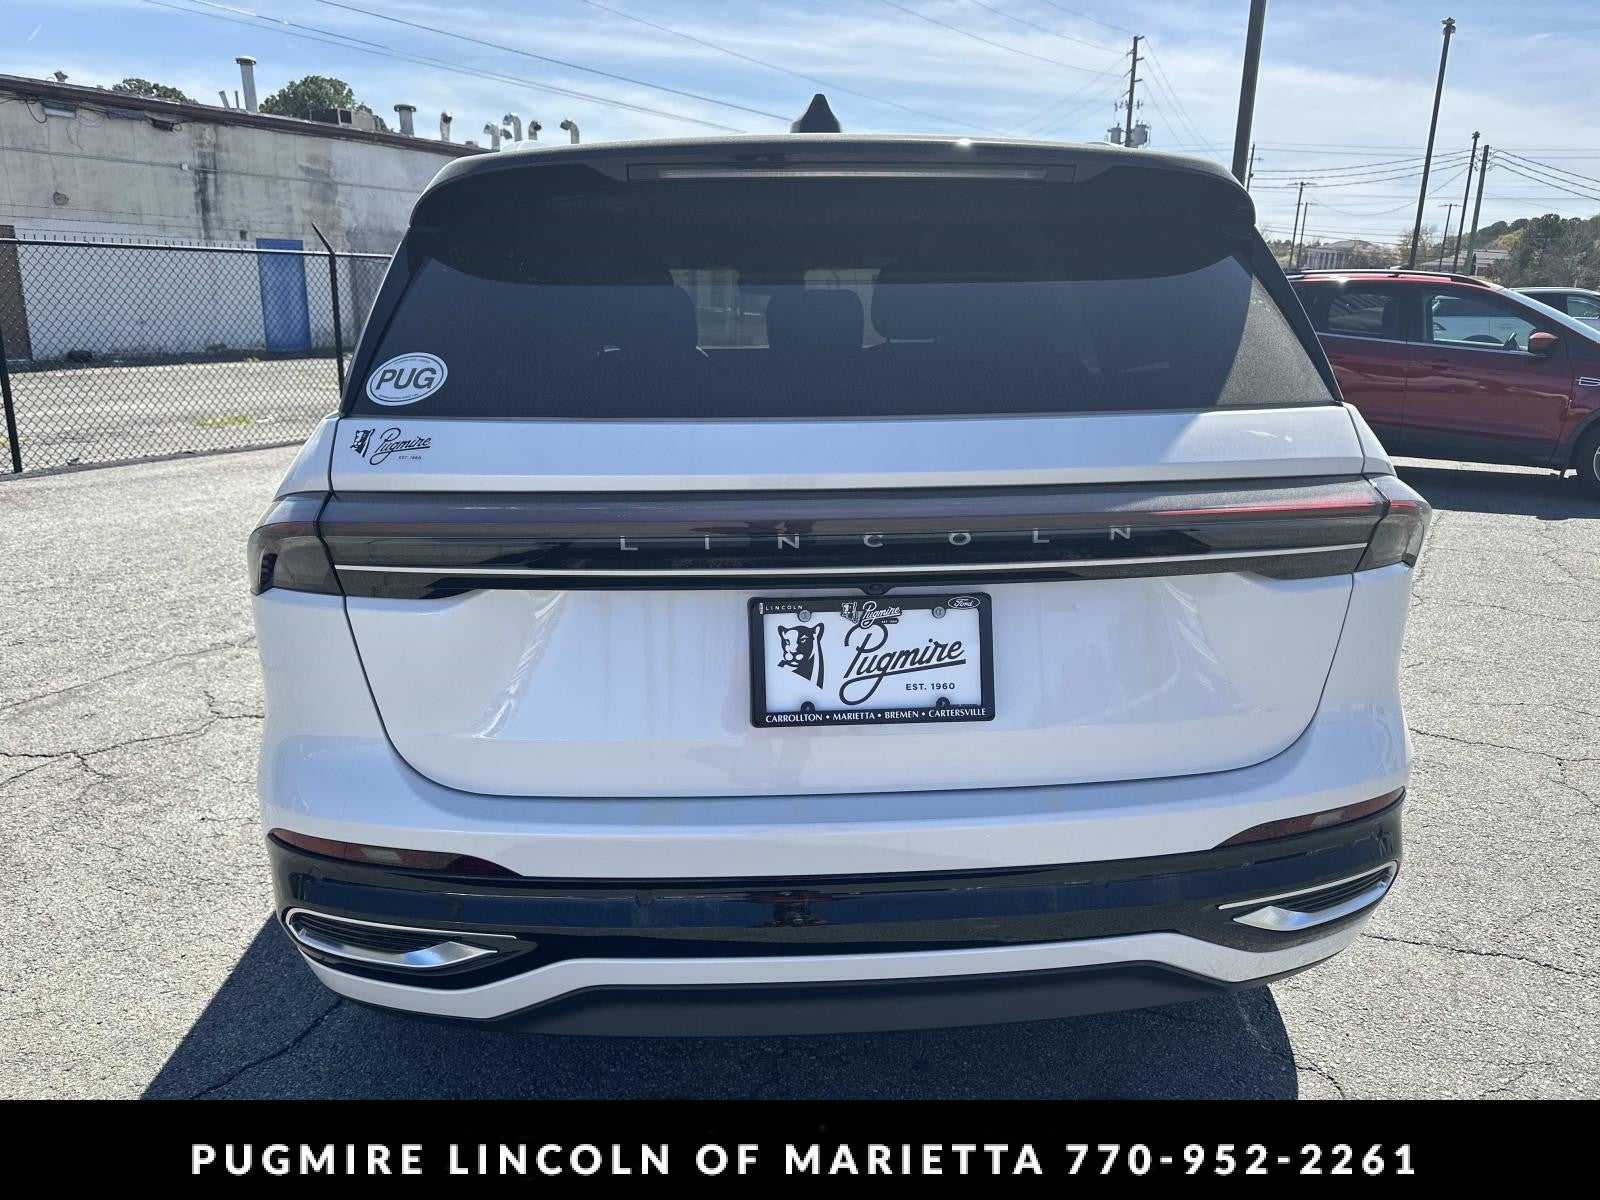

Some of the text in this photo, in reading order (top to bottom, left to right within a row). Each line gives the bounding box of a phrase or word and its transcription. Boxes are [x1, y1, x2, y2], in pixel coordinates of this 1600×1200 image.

[375, 367, 437, 391] PUG
[369, 427, 432, 466] Pugmire
[619, 524, 1132, 552] LINCOLN
[860, 600, 902, 629] Pugmire
[839, 622, 967, 706] Pugmire
[905, 682, 956, 691] EST. 1960
[765, 708, 987, 724] CARROLLTON MARIETTA BREMEN CARTERSVILLE
